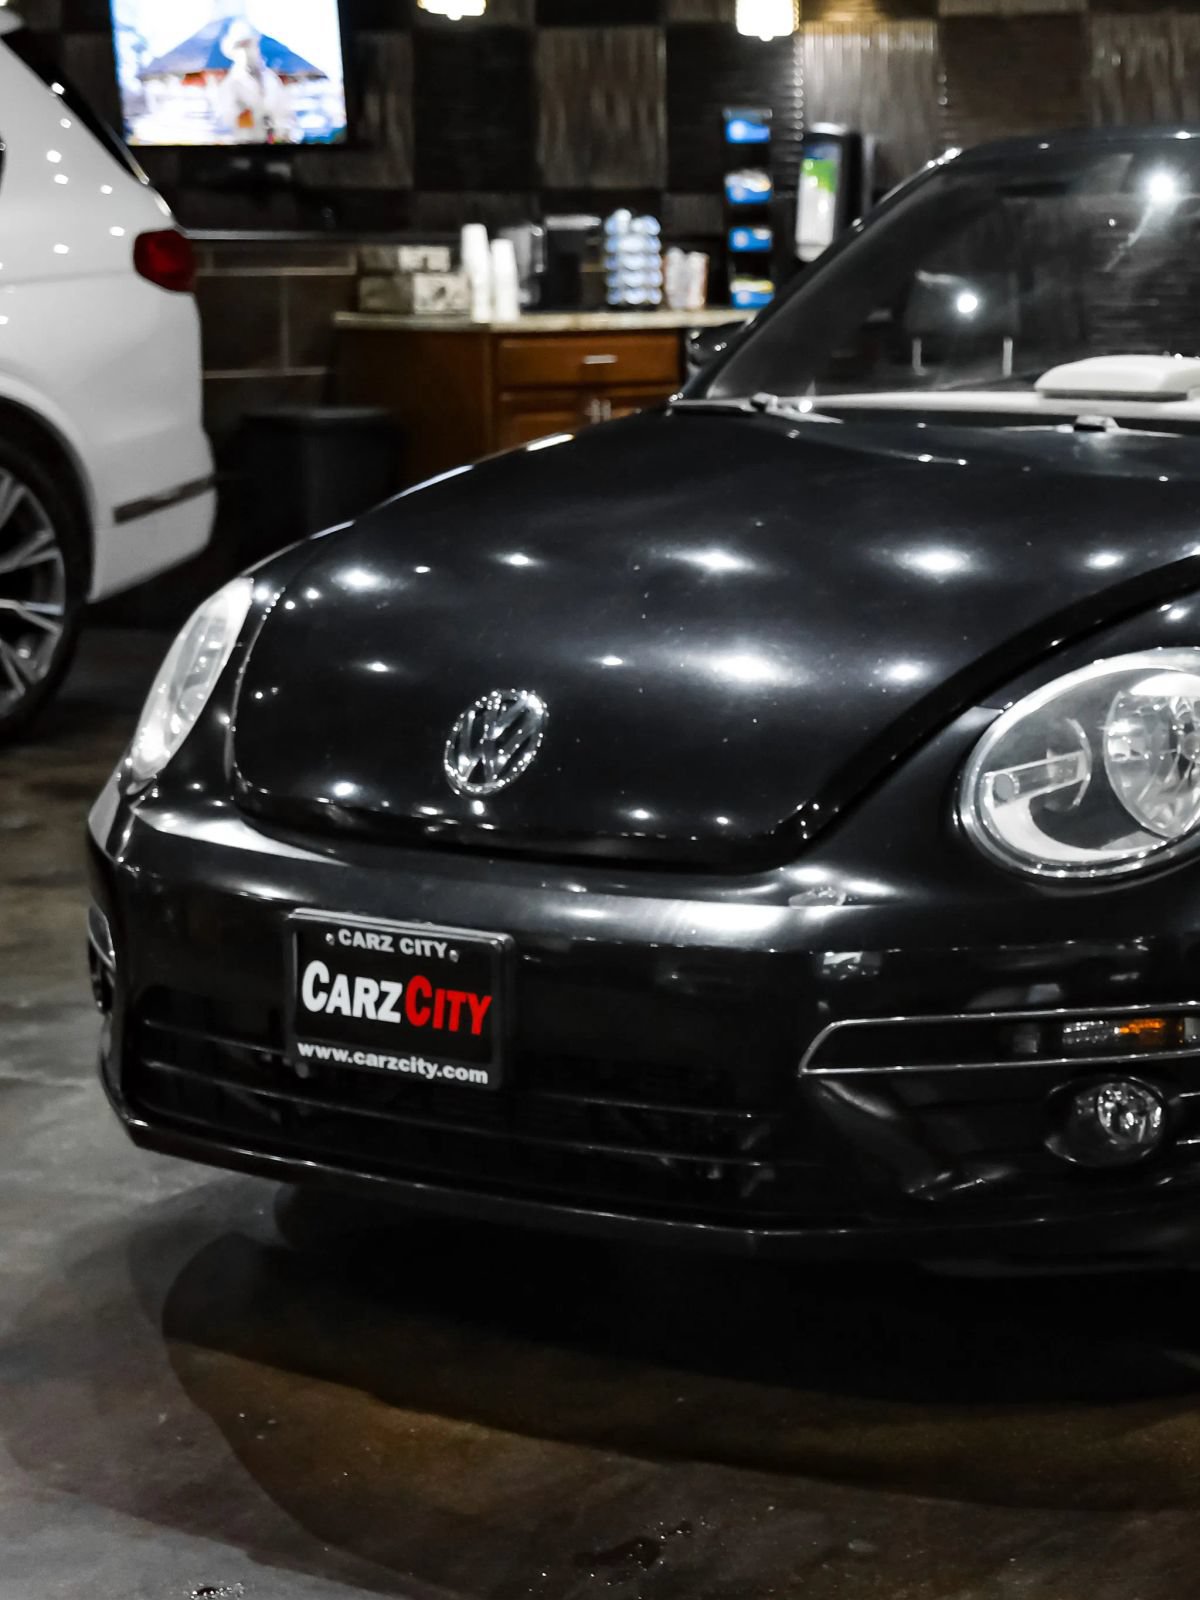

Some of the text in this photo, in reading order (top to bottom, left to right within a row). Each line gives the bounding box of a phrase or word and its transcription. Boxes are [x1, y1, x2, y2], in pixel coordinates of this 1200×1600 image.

[338, 928, 449, 959] CARZ CITY
[296, 1042, 489, 1085] www.carzcity.com
